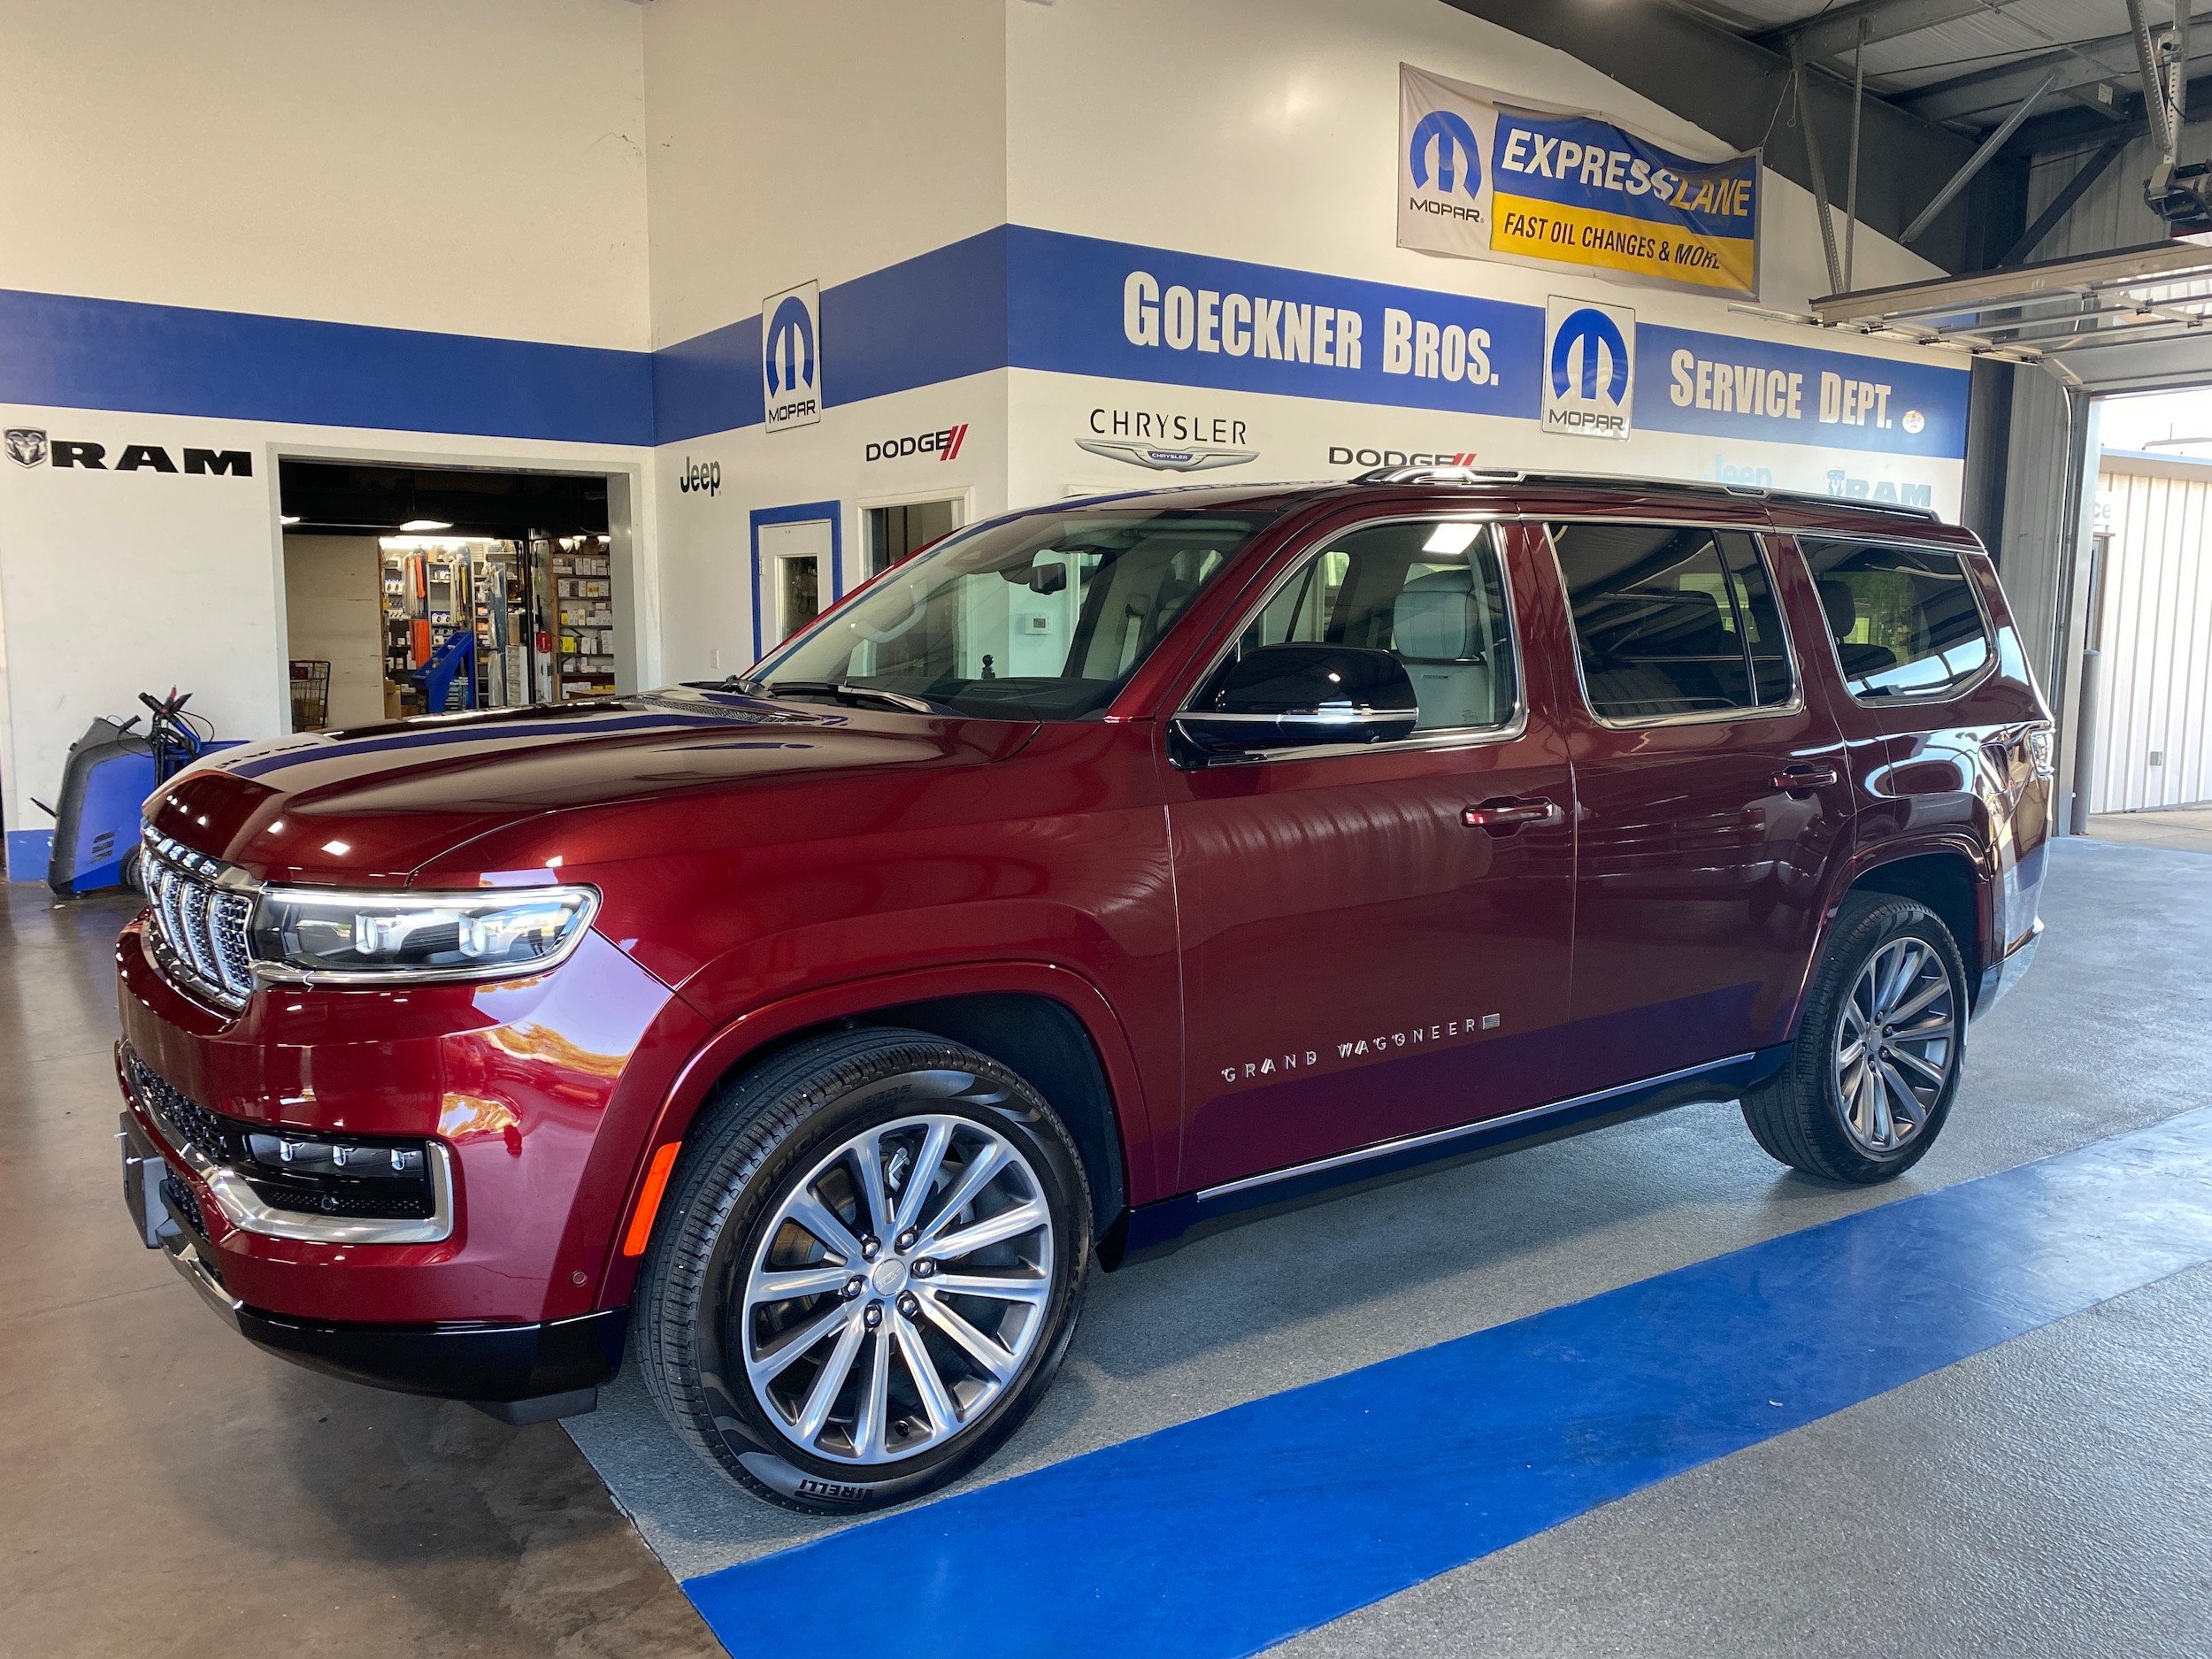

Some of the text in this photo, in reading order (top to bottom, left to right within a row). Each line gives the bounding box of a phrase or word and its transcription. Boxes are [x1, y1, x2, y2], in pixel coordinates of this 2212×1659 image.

[1409, 196, 1480, 223] MOPAR
[1503, 212, 1548, 240] FAST
[1550, 221, 1576, 246] OIL
[1582, 226, 1655, 258] CHANGES
[1659, 241, 1670, 262] &
[769, 399, 817, 424] MOPAR
[1090, 408, 1247, 445] CHRYSLER
[1548, 408, 1624, 431] MOPAR
[50, 440, 253, 478] RAM
[866, 429, 953, 462] DODGE
[680, 456, 721, 497] Jeep
[1846, 479, 1932, 507] RAM
[1223, 1018, 1475, 1082] GRAND WAGONEER
